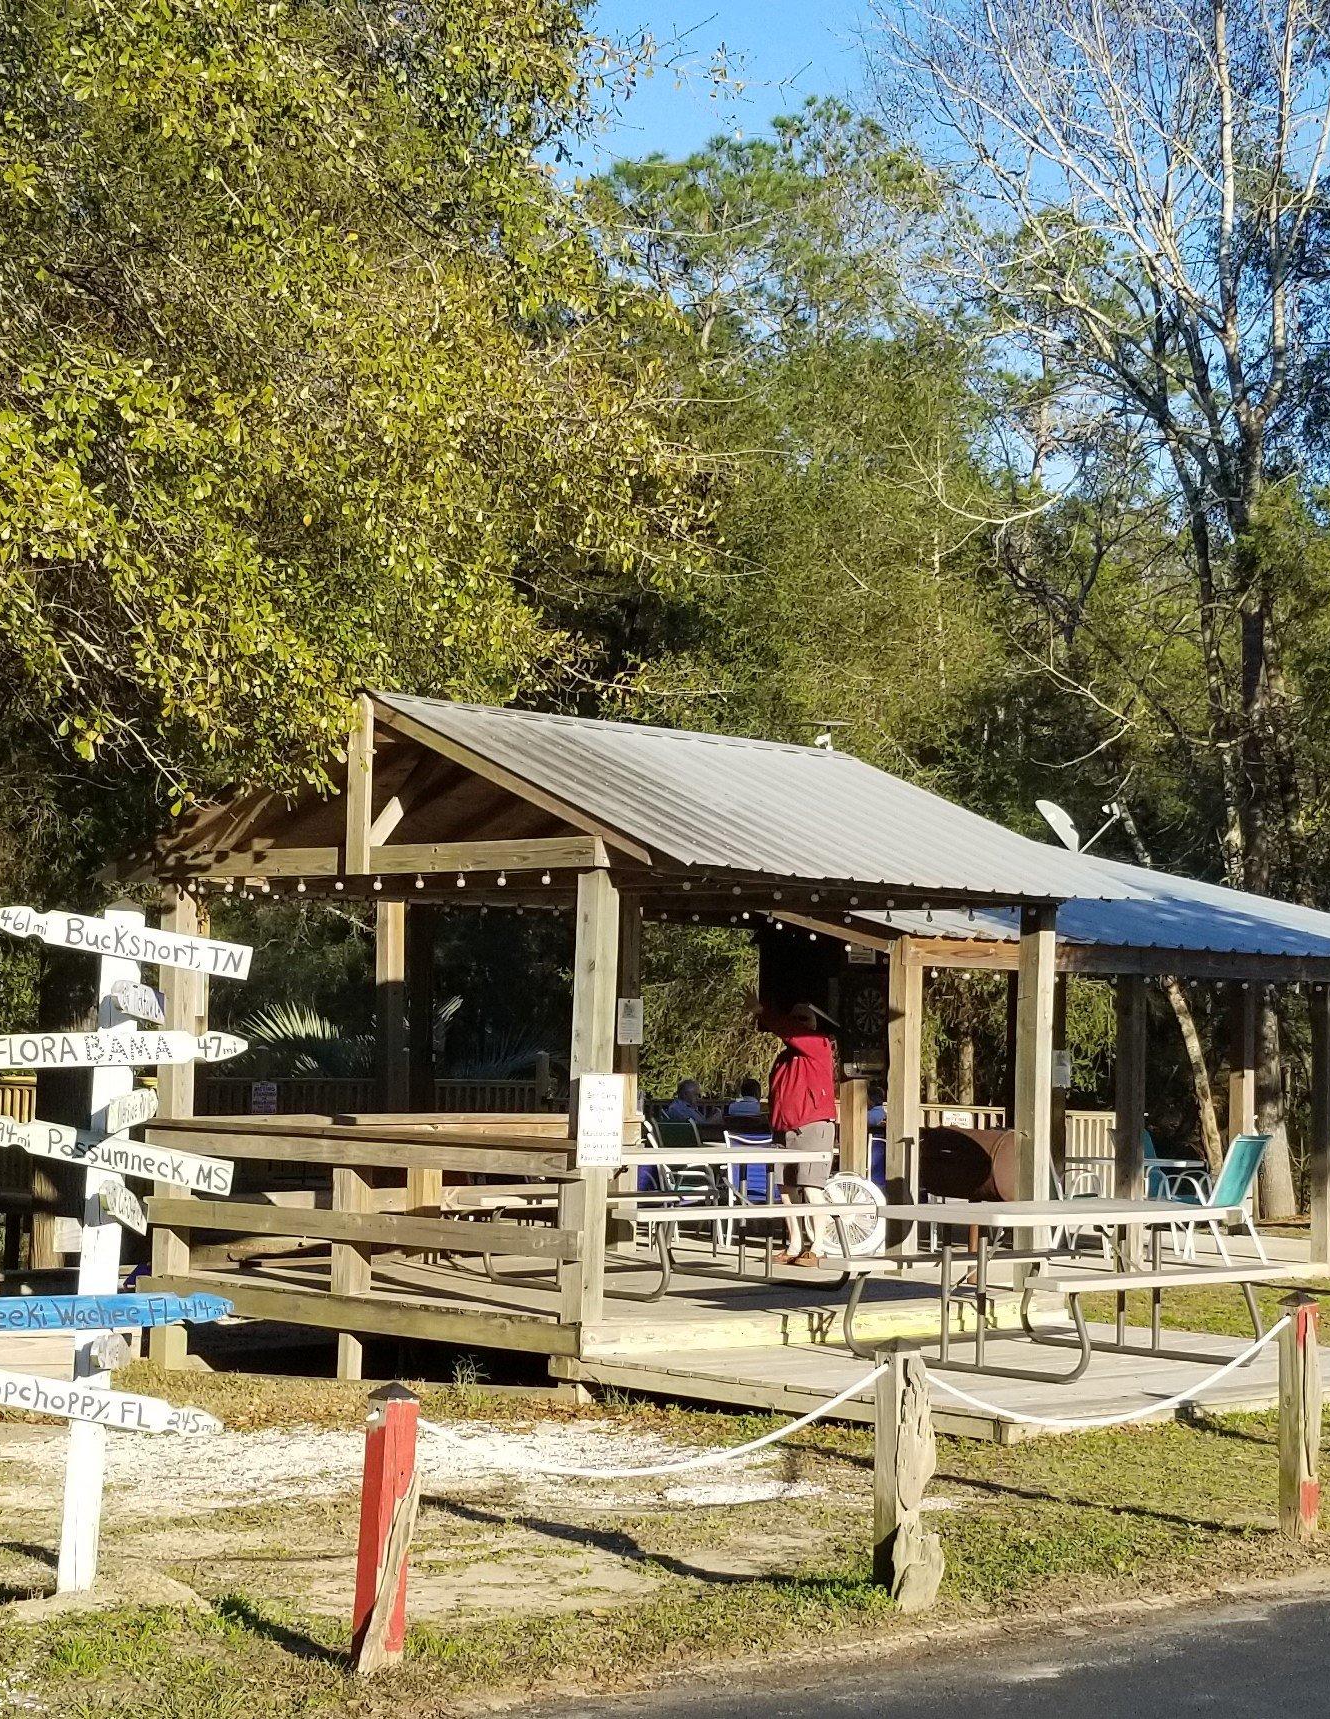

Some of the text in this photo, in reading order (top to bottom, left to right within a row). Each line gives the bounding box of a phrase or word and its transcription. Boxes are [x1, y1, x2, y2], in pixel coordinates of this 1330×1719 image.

[207, 945, 244, 973] TN
[195, 1163, 230, 1191] MS
[121, 1401, 150, 1428] FL
